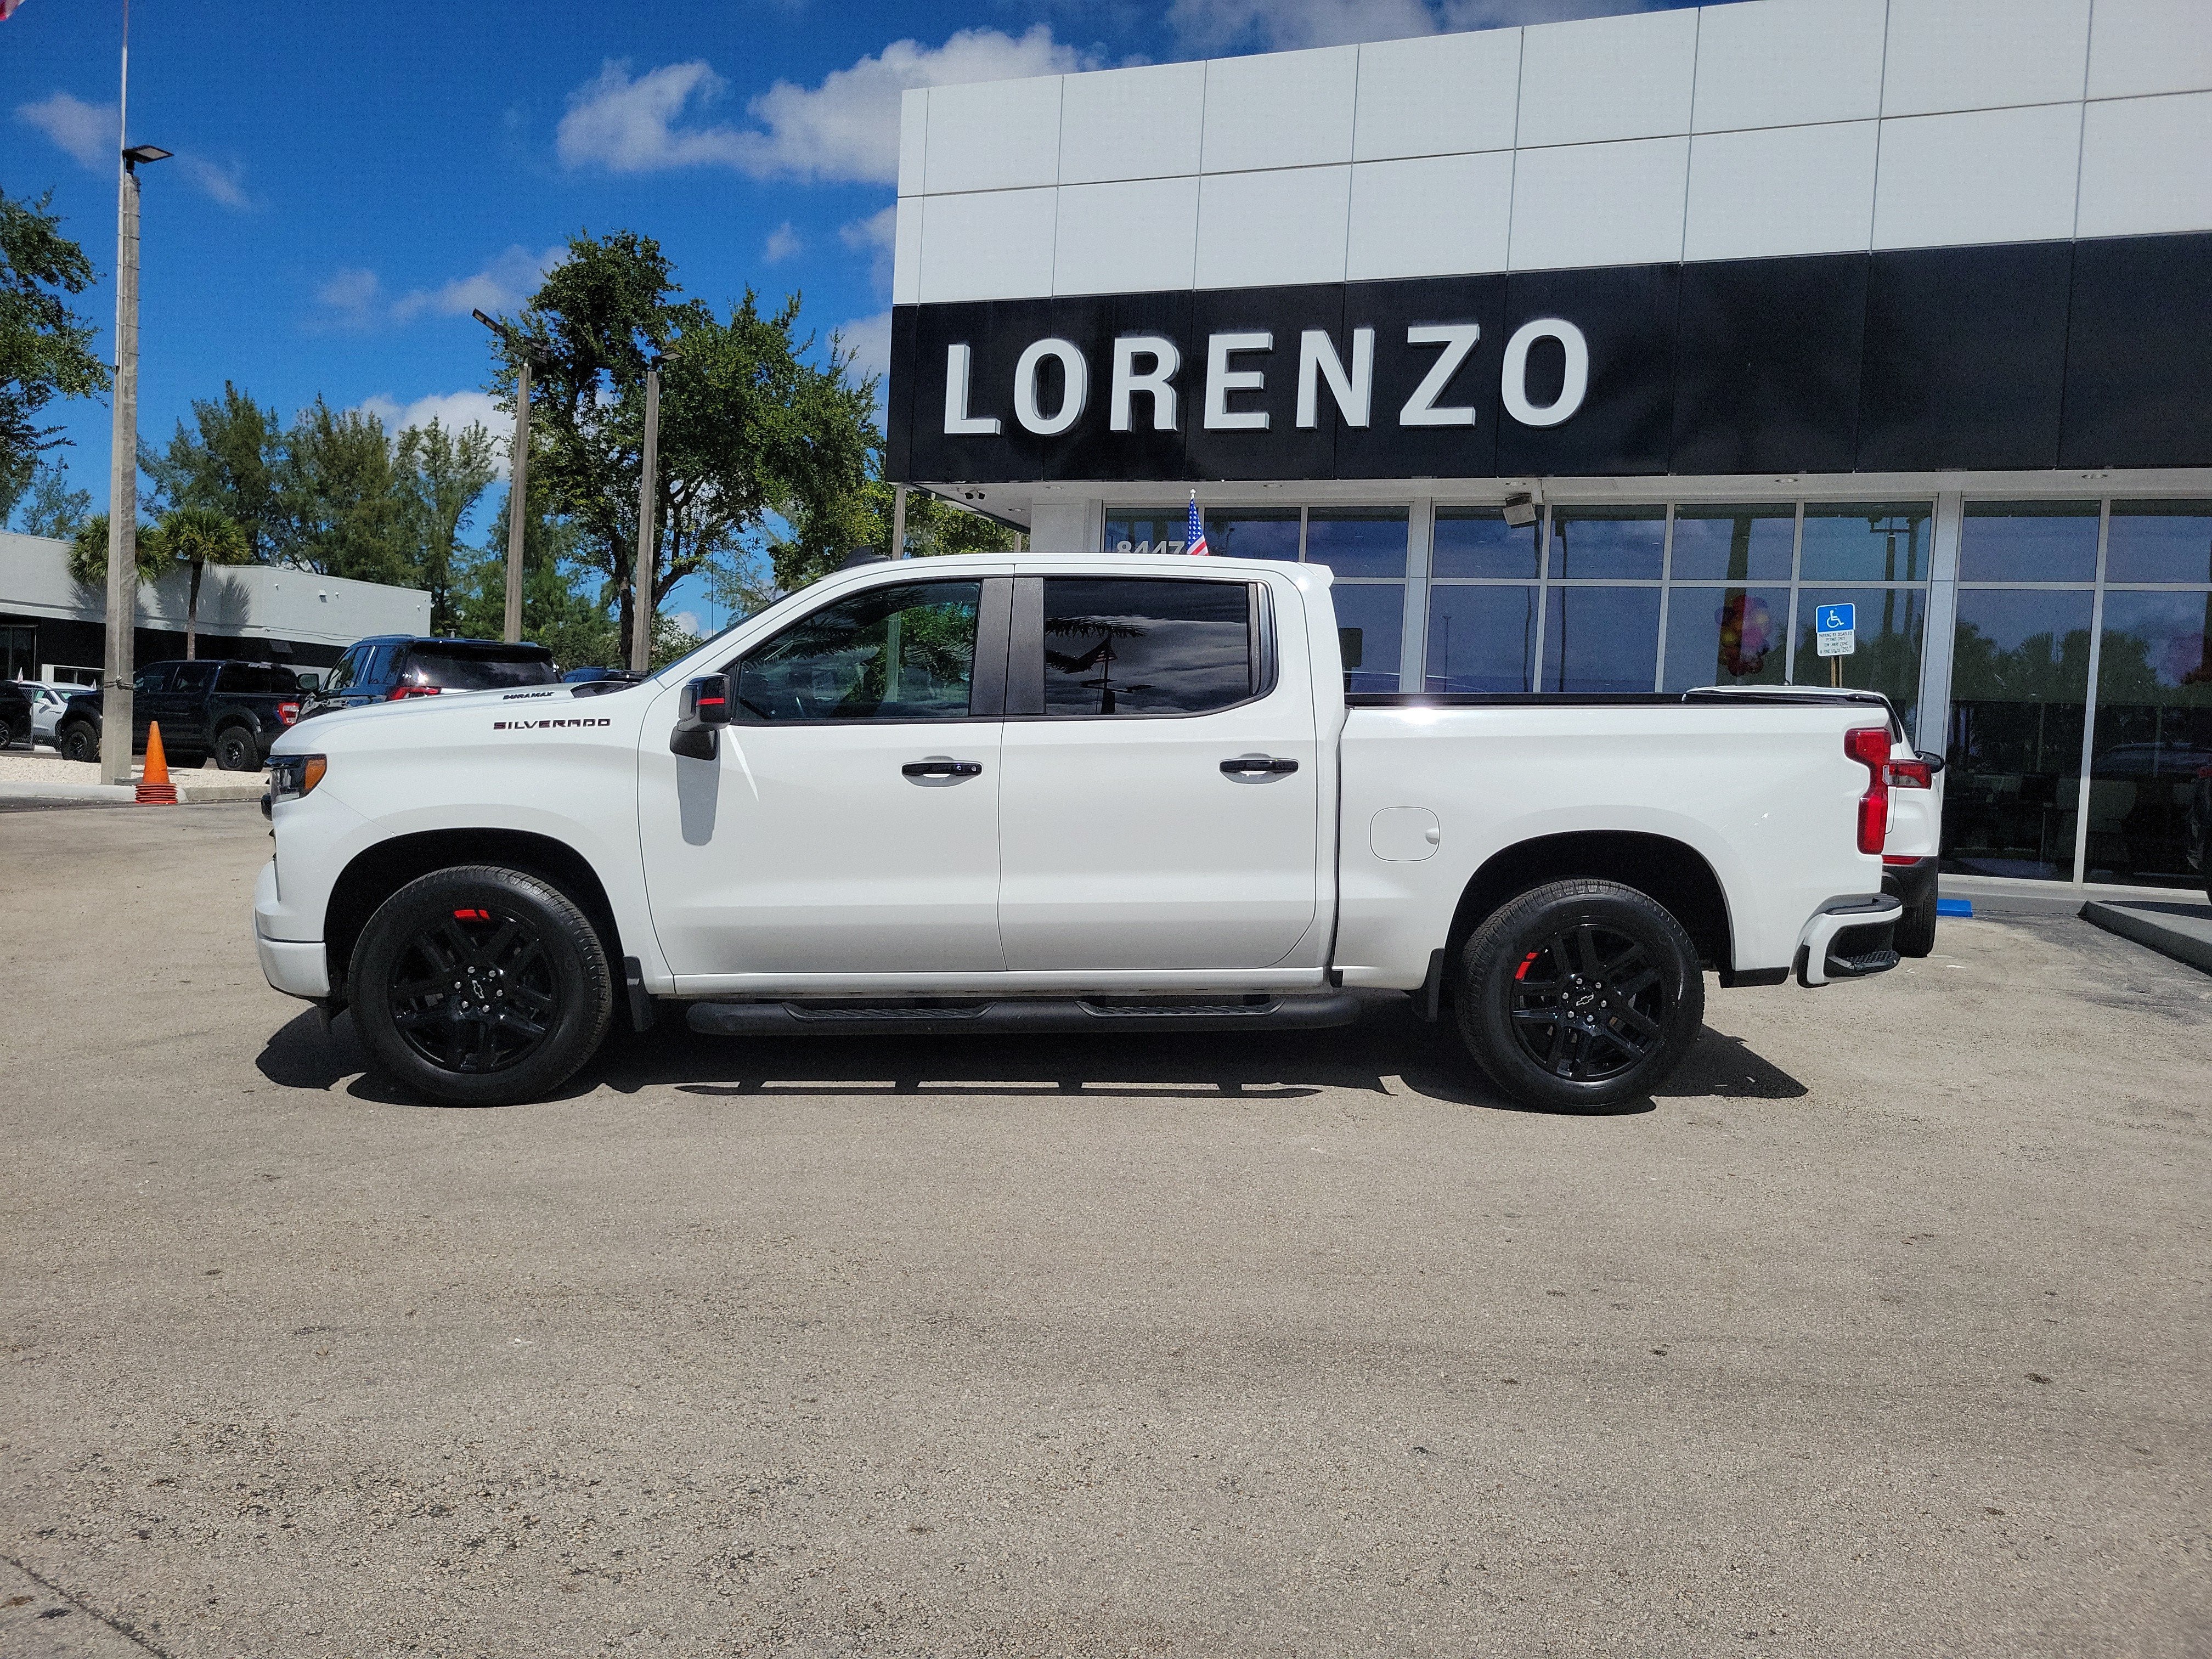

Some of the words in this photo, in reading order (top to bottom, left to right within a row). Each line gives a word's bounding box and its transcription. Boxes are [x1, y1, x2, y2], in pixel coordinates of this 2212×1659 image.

[944, 318, 1589, 436] LORENZO
[1116, 541, 1185, 554] 8447
[503, 691, 555, 700] DURAMAX
[493, 718, 611, 730] SILVERADO
